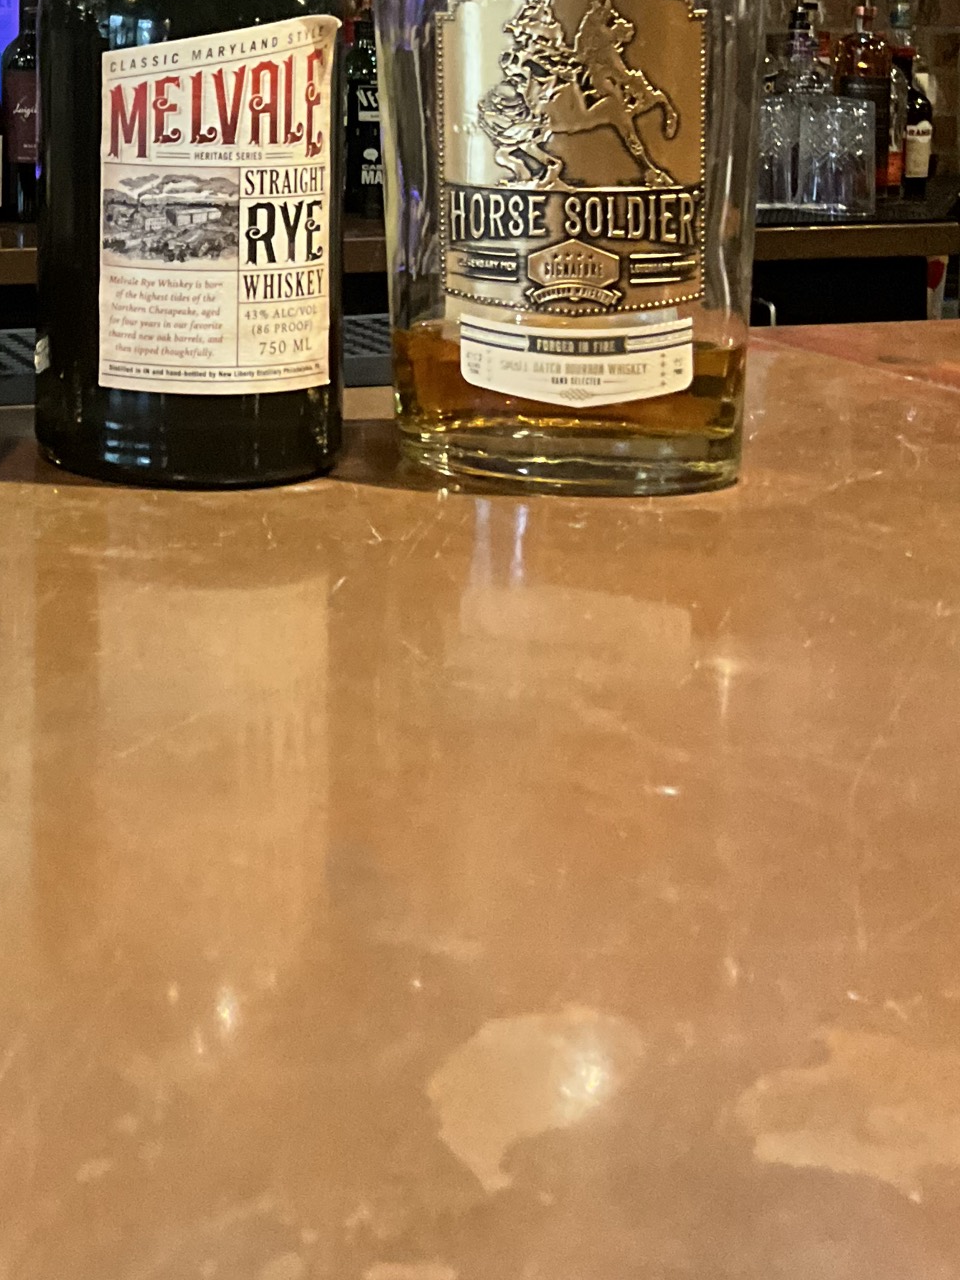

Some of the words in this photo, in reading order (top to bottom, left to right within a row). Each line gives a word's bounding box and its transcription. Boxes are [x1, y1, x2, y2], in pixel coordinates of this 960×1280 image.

[110, 52, 179, 73] CLASSIC
[191, 36, 278, 61] MARYLAND
[287, 25, 325, 45] STYLE
[108, 48, 324, 159] MELVALE
[194, 151, 233, 160] HERITAGE
[236, 151, 262, 160] SERIES
[245, 166, 326, 196] STRAIGHT
[450, 190, 547, 241] HORSE
[564, 192, 696, 245] SOLDIER
[245, 200, 323, 266] RYE
[544, 262, 605, 279] SIGNATURE
[109, 275, 138, 286] Melvale
[141, 278, 155, 288] Rye
[158, 279, 193, 290] Whiskey
[195, 280, 202, 288] is
[243, 269, 324, 300] WHISKEY
[115, 290, 124, 299] of
[125, 290, 137, 299] the
[139, 291, 168, 303] highest
[170, 293, 190, 302] tides
[192, 294, 201, 304] of
[203, 294, 216, 302] the
[111, 302, 146, 313] Northern
[148, 306, 199, 317] Chesapeake,
[201, 307, 221, 319] aged
[245, 309, 269, 320] 43%
[272, 304, 317, 319] ALC/VOL
[109, 315, 120, 326] for
[122, 316, 138, 326] four
[140, 320, 161, 329] years
[163, 320, 171, 328] in
[189, 320, 223, 331] favorite
[251, 324, 270, 336] (86
[274, 320, 313, 333] PROOF)
[108, 329, 136, 339] charred
[138, 333, 154, 341] new
[157, 333, 171, 342] oak
[174, 334, 205, 344] barrels,
[208, 335, 224, 343] and
[115, 343, 131, 352] then
[134, 346, 159, 356] sipped
[161, 346, 214, 359] thoughtfully.
[259, 340, 287, 355] 750
[293, 337, 312, 353] ML
[536, 338, 575, 353] FORGED
[578, 340, 589, 353] IN
[593, 339, 617, 352] FIRE
[109, 364, 133, 373] Distilled
[152, 368, 164, 376] and
[166, 368, 207, 377] hand-bottled
[209, 370, 216, 378] by
[218, 370, 232, 378] New
[234, 370, 254, 378] Liberty
[608, 363, 647, 375] WHISKEY
[551, 377, 568, 385] HAND
[570, 377, 602, 386] SELECTED
